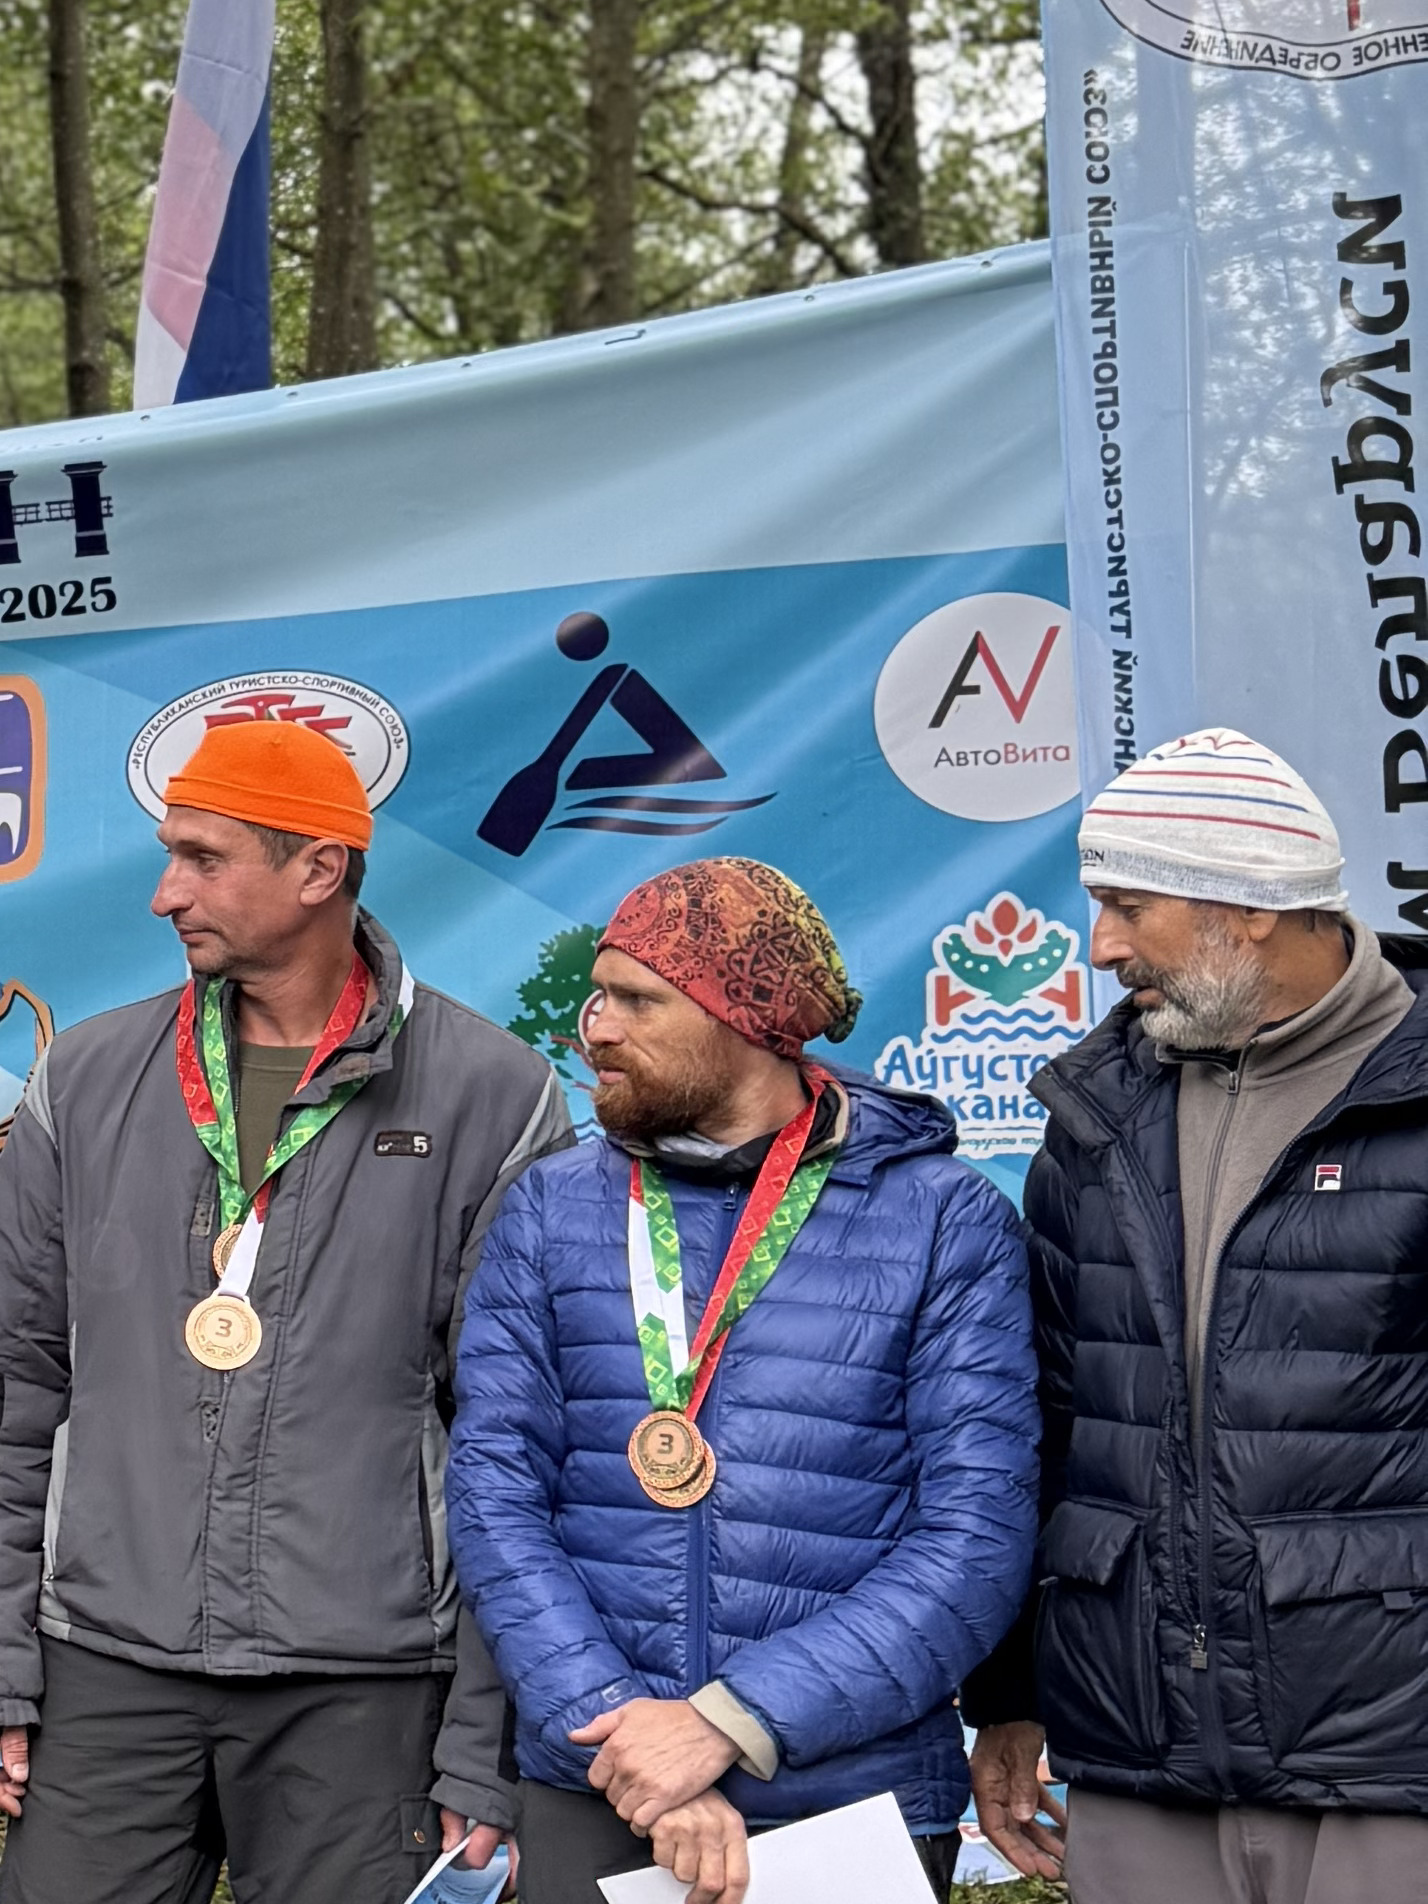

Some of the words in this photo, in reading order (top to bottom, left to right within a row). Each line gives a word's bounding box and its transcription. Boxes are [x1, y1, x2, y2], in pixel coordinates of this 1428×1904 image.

[933, 741, 1071, 769] АвтоВита
[947, 1093, 1048, 1122] кана
[215, 1317, 233, 1339] 3
[657, 1433, 674, 1455] 3
